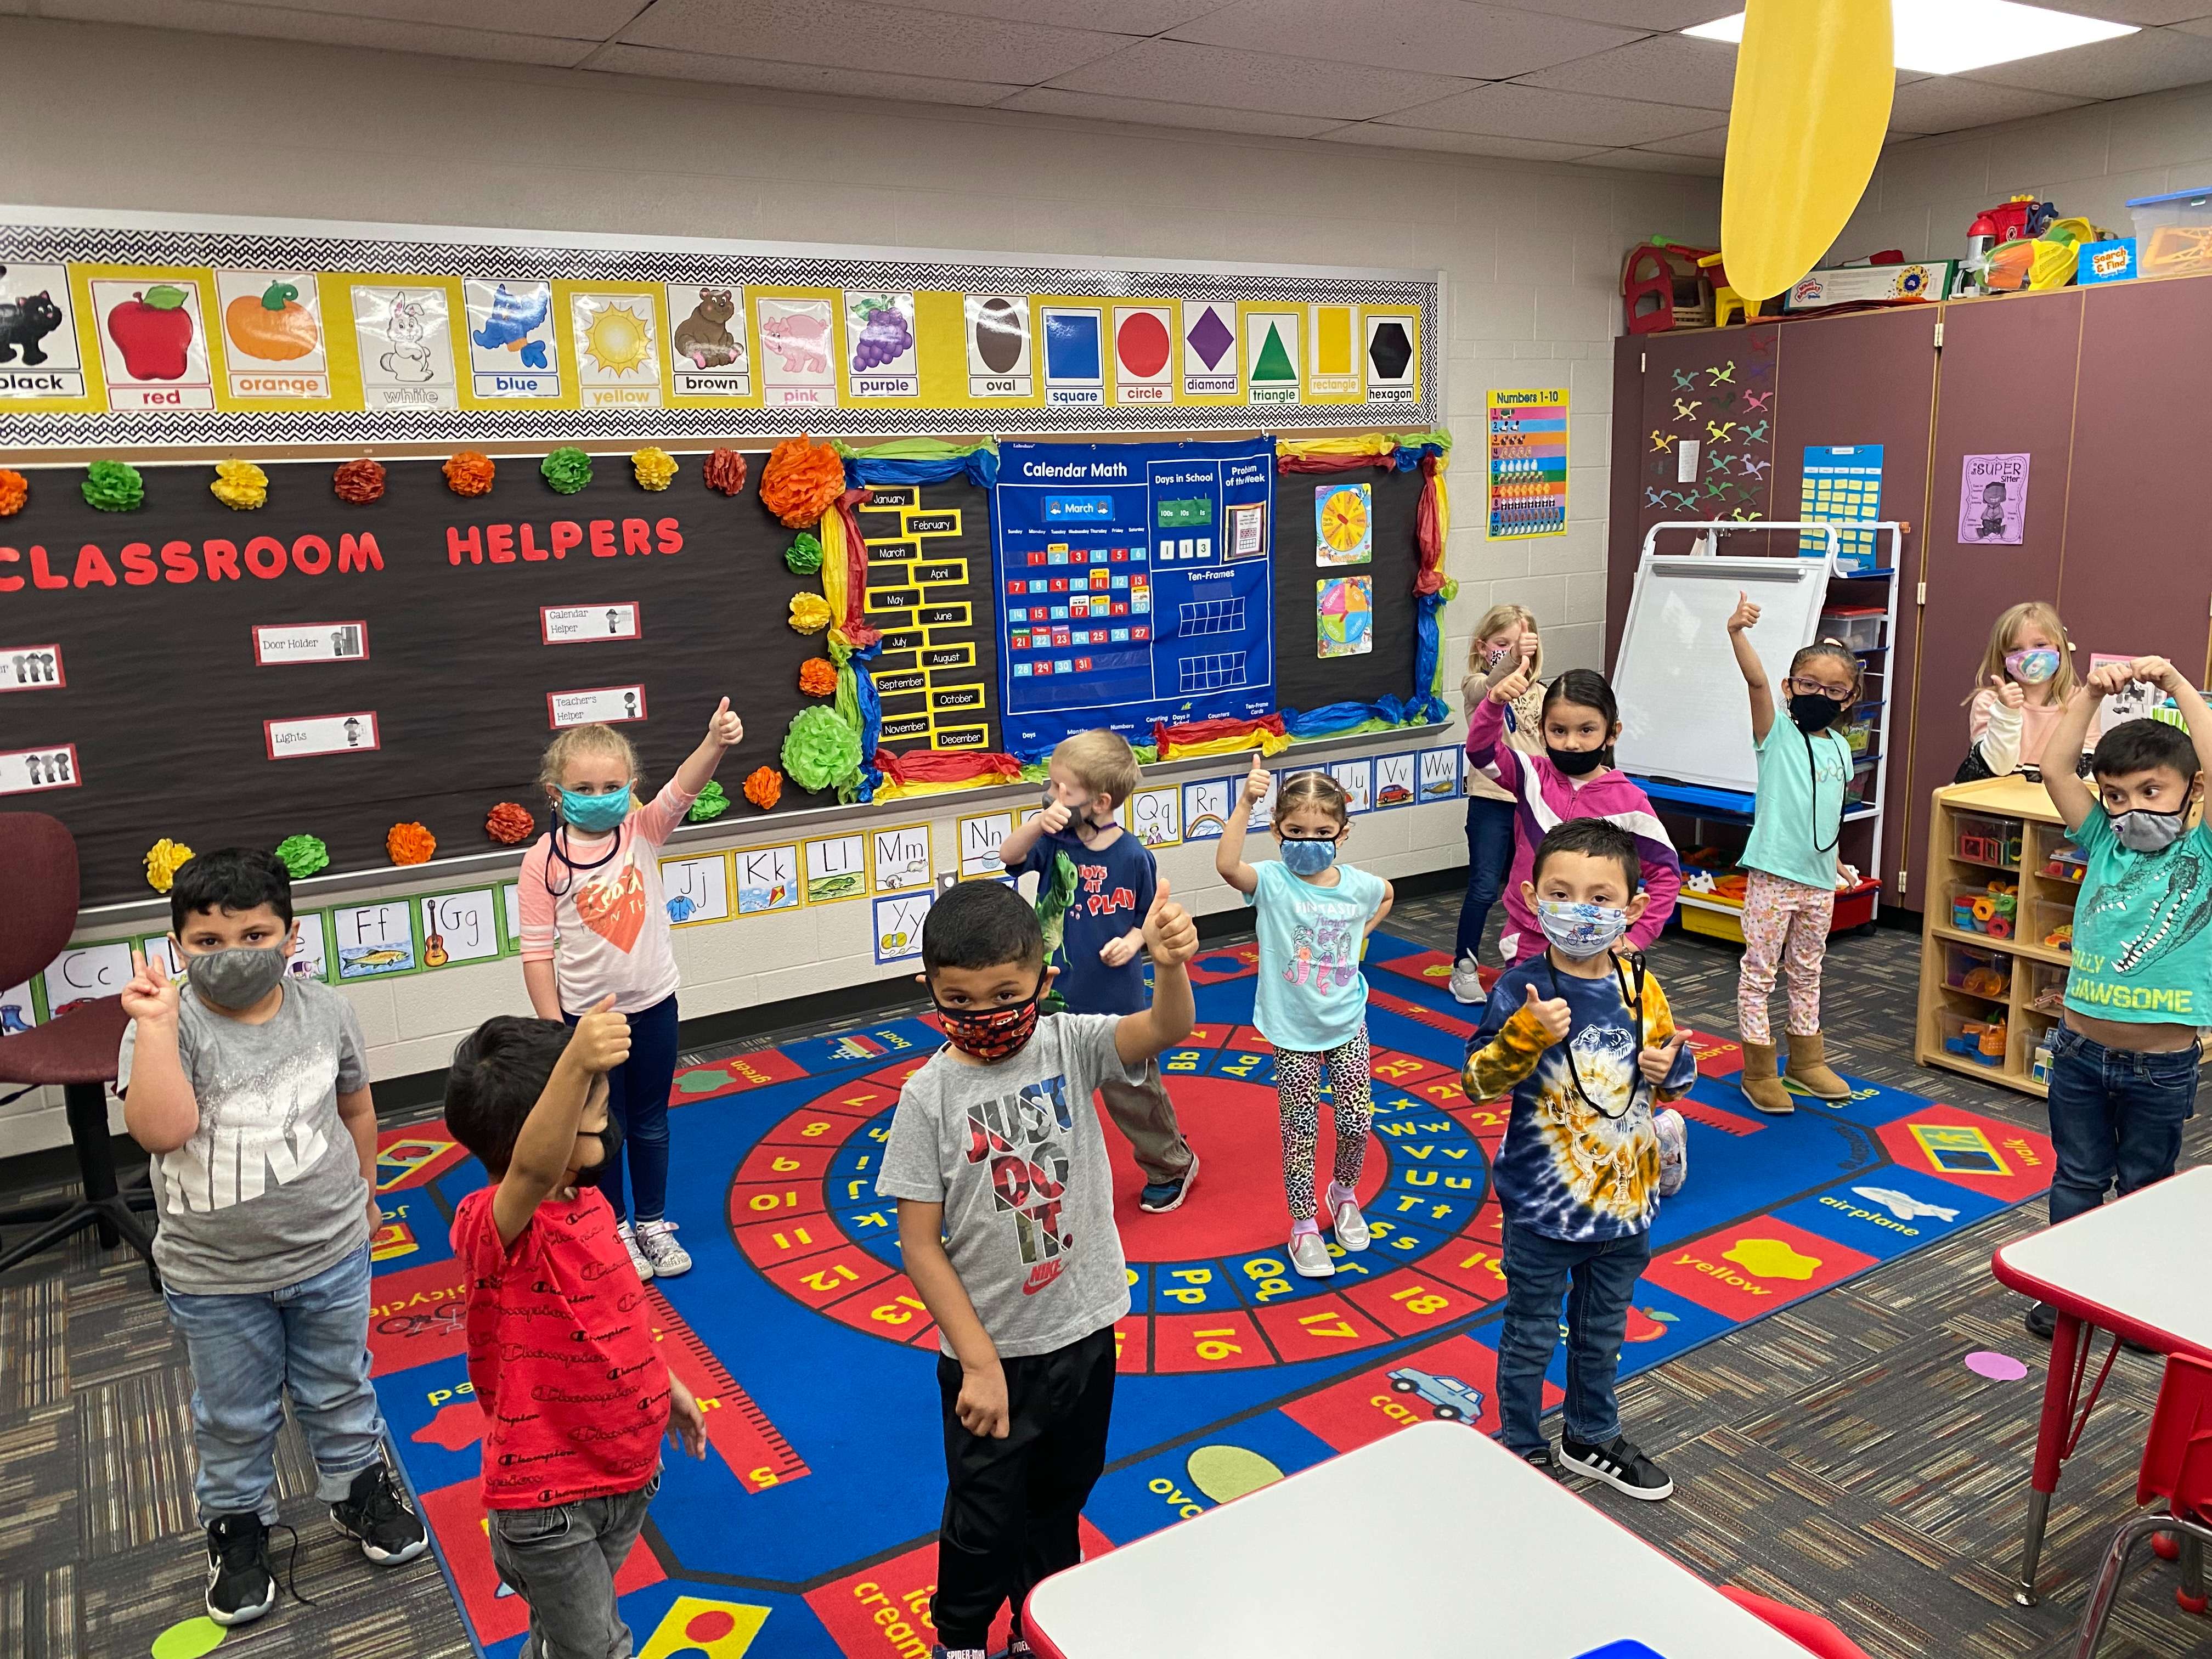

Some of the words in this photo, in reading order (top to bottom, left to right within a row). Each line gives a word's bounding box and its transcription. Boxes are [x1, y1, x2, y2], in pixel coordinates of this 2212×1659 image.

[2093, 248, 2126, 263] Search
[2097, 264, 2104, 273] &
[2107, 258, 2125, 270] Find
[239, 377, 319, 392] orange
[496, 377, 538, 390] blue
[686, 377, 738, 390] brown
[860, 379, 909, 393] purple
[987, 380, 1015, 391] oval
[1188, 379, 1235, 390] diamond
[1313, 380, 1356, 391] rectangle
[143, 390, 181, 404] red
[384, 388, 438, 403] white
[593, 388, 650, 404] yellow
[784, 389, 818, 405] pink
[1053, 390, 1098, 404] square
[1127, 387, 1163, 399] circle
[1253, 390, 1296, 403] triangle
[1369, 388, 1412, 401] hexagon
[1497, 392, 1537, 404] Numbers
[1541, 391, 1558, 402] 1-10
[1023, 461, 1087, 477] Calendar
[1091, 462, 1127, 477] Math
[1155, 476, 1174, 485] Days
[1176, 474, 1183, 483] in
[1186, 473, 1213, 482] School
[1226, 477, 1234, 486] of
[874, 495, 905, 505] January
[1065, 503, 1093, 513] March
[913, 521, 950, 531] February
[0, 532, 383, 591] CLASSROOM
[446, 517, 683, 566] HELPERS
[879, 548, 905, 558] March
[930, 569, 948, 580] April
[1075, 579, 1084, 588] 10
[1096, 579, 1102, 588] 11
[1116, 578, 1124, 586] 12
[1135, 576, 1143, 585] 13
[1188, 570, 1234, 581] Ten-Frames
[887, 595, 904, 606] May
[1325, 588, 1341, 608] Summer
[550, 610, 588, 619] Calendar
[934, 612, 952, 621] June
[1013, 610, 1022, 619] 14
[1035, 610, 1043, 618] 15
[1055, 608, 1064, 617] 16
[1075, 607, 1084, 616] 17
[1096, 606, 1104, 614] 18
[1115, 604, 1124, 613] 19
[1136, 603, 1146, 611] 20
[551, 625, 578, 634] Helper
[1017, 637, 1025, 646] 21
[1036, 636, 1047, 645] 22
[1057, 635, 1066, 644] 23
[1075, 633, 1086, 642] 24
[1093, 632, 1104, 641] 25
[1114, 630, 1125, 639] 26
[1135, 629, 1146, 637] 27
[263, 640, 285, 650] Door
[287, 639, 318, 648] Holder
[892, 637, 906, 647] July
[933, 653, 960, 664] August
[1018, 665, 1028, 674] 28
[1037, 663, 1048, 673] 29
[1058, 662, 1069, 670] 30
[1079, 659, 1087, 668] 31
[879, 678, 923, 691] September
[556, 696, 597, 707] Teacher's
[940, 694, 973, 704] October
[557, 712, 584, 721] Helper
[885, 721, 926, 734] November
[1023, 731, 1036, 739] Days
[275, 732, 307, 744] Lights
[941, 733, 980, 744] December
[1384, 759, 1407, 782] Vv
[1424, 752, 1453, 778] Ww
[1197, 787, 1217, 812] Rr
[1137, 794, 1176, 834] Qq
[972, 820, 1002, 848] Nn
[879, 833, 924, 865] Mm
[747, 853, 786, 884] Kk
[1079, 864, 1107, 879] TOYS
[680, 862, 706, 908] Jj
[1084, 879, 1102, 893] AT
[1087, 887, 1136, 917] PLAY
[356, 907, 390, 946] Ff
[440, 897, 478, 946] Gg
[893, 901, 926, 945] Yy
[63, 952, 111, 986] Cc
[2072, 978, 2193, 1012] JAWSOME
[876, 1030, 912, 1049] boat
[1167, 1051, 1199, 1071] Bb
[1221, 1055, 1262, 1077] Aa
[1375, 1059, 1424, 1078] 25
[730, 1059, 771, 1084] green
[965, 1074, 1073, 1165] JUST
[802, 1122, 831, 1137] 8
[1376, 1121, 1452, 1137] Ww
[1400, 1145, 1469, 1160] Vv
[2002, 1138, 2042, 1166] walk
[989, 1142, 1069, 1213] DO
[1405, 1170, 1472, 1190] Uu
[749, 1192, 797, 1211] 10
[1396, 1195, 1453, 1220] Tt
[1819, 1195, 1920, 1237] airplane
[772, 1228, 812, 1249] 11
[799, 1265, 859, 1291] 12
[1029, 1259, 1062, 1284] NIKE
[1243, 1257, 1294, 1302] Qq
[1672, 1254, 1773, 1296] yellow
[1163, 1268, 1212, 1304] Pp
[1390, 1285, 1449, 1315] 18
[871, 1295, 926, 1324] 13
[1299, 1312, 1359, 1339] 17
[1193, 1328, 1242, 1361] 16
[500, 1342, 610, 1370] Champion
[607, 1356, 656, 1380] Champion
[1370, 1396, 1422, 1425] car
[498, 1448, 577, 1466] Champion
[538, 1483, 614, 1503] Champion
